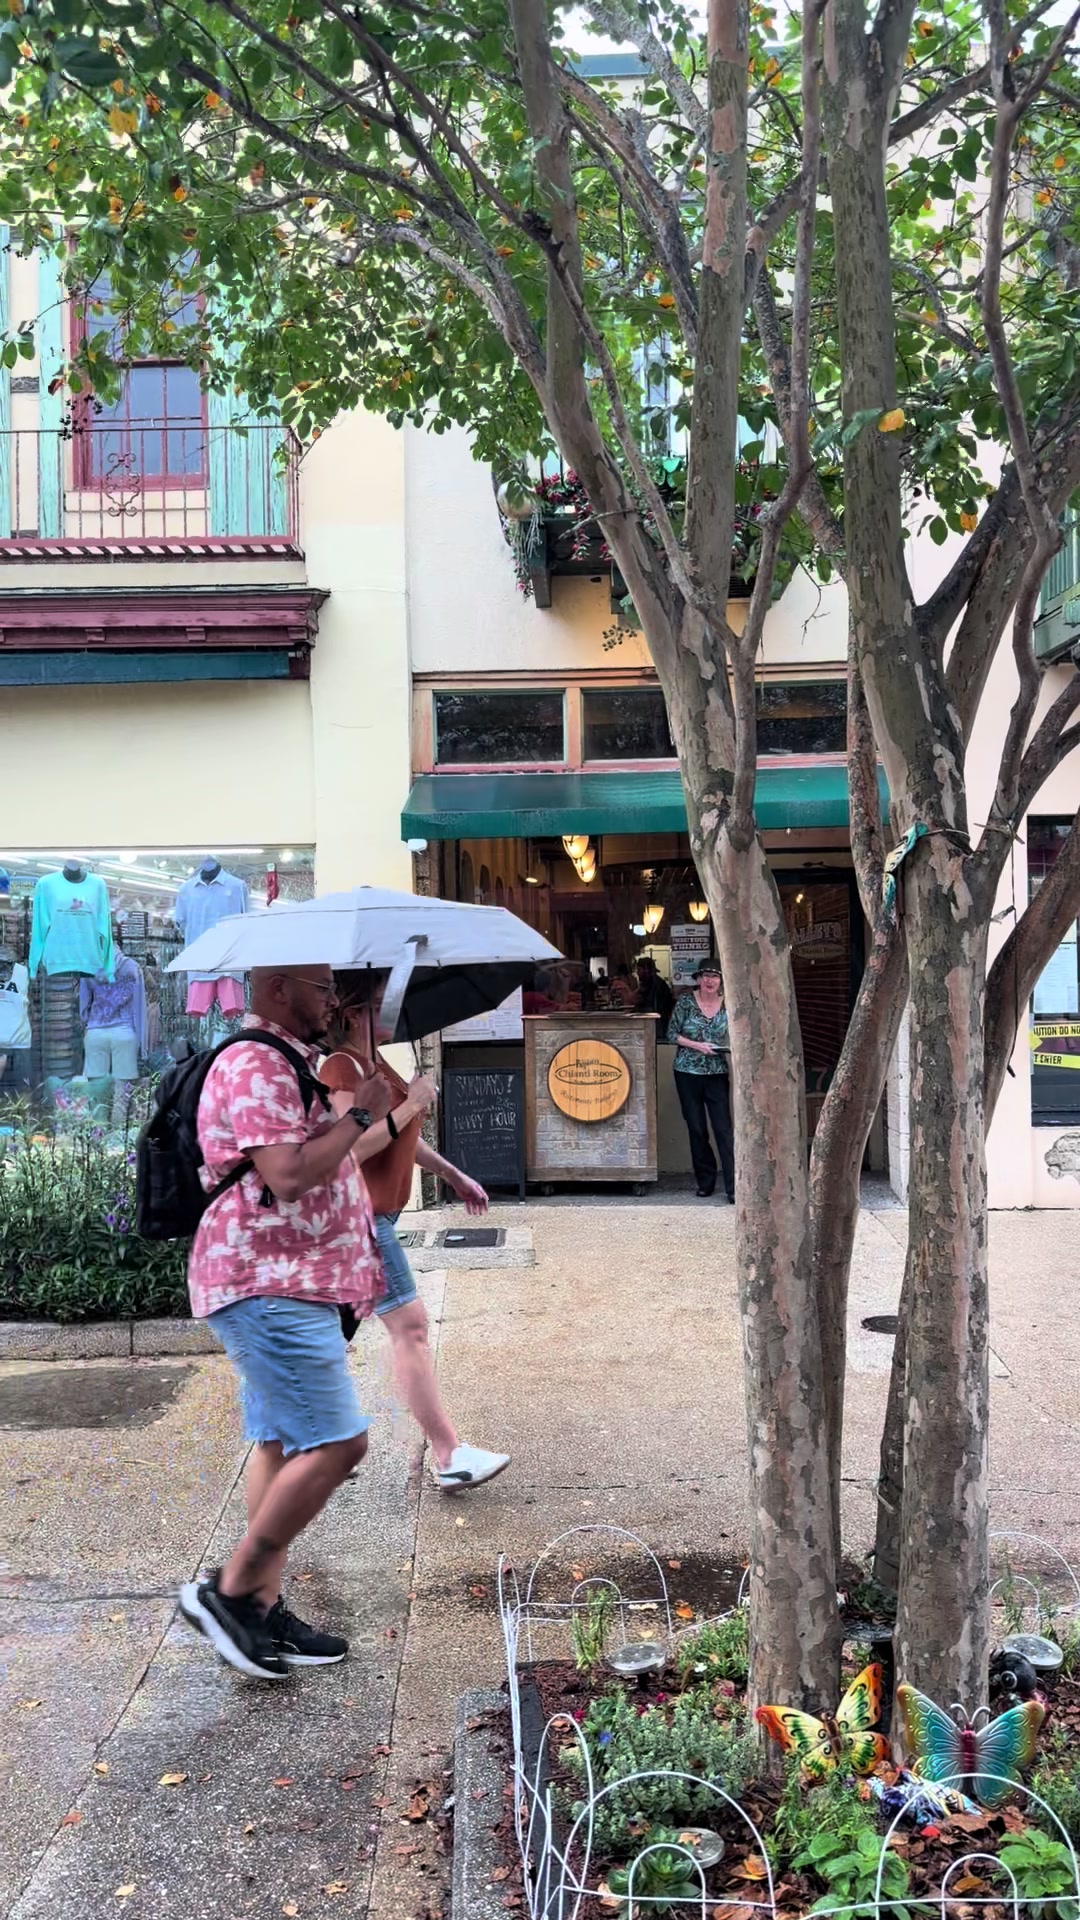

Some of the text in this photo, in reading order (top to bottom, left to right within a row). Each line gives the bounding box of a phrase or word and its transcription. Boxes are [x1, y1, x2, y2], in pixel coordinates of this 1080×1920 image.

[1059, 1026, 1069, 1035] DO
[1040, 1053, 1062, 1065] ENTER
[593, 1069, 619, 1078] Room
[490, 1111, 516, 1127] HOUR
